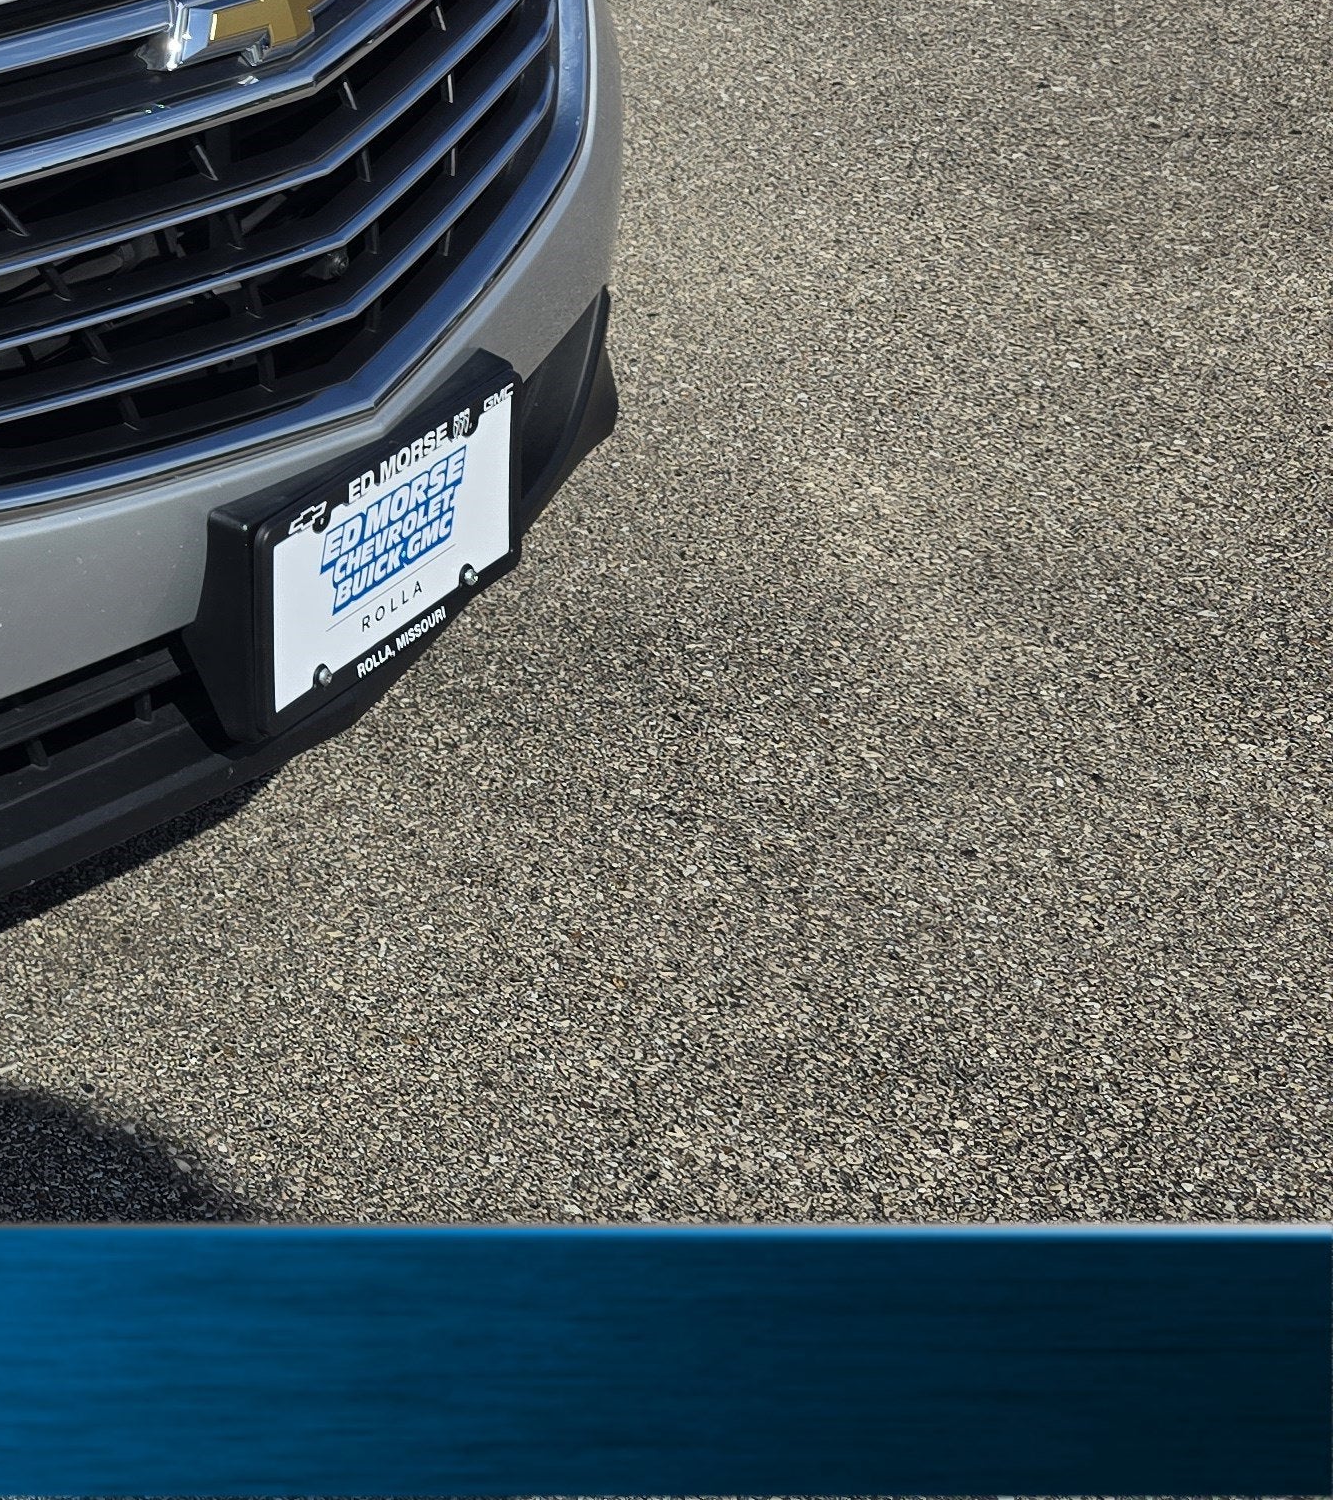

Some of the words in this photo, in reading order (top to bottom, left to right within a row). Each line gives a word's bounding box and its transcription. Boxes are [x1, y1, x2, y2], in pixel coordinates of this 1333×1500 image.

[483, 382, 514, 411] GMC
[348, 470, 375, 504] ED
[379, 422, 448, 486] MORSE
[320, 514, 364, 570] ED
[363, 448, 466, 540] MORSE
[333, 486, 455, 584] CHEVROLET
[356, 644, 396, 679] ROLLA,
[395, 605, 447, 652] MISSOURI
[361, 580, 423, 633] ROLLA
